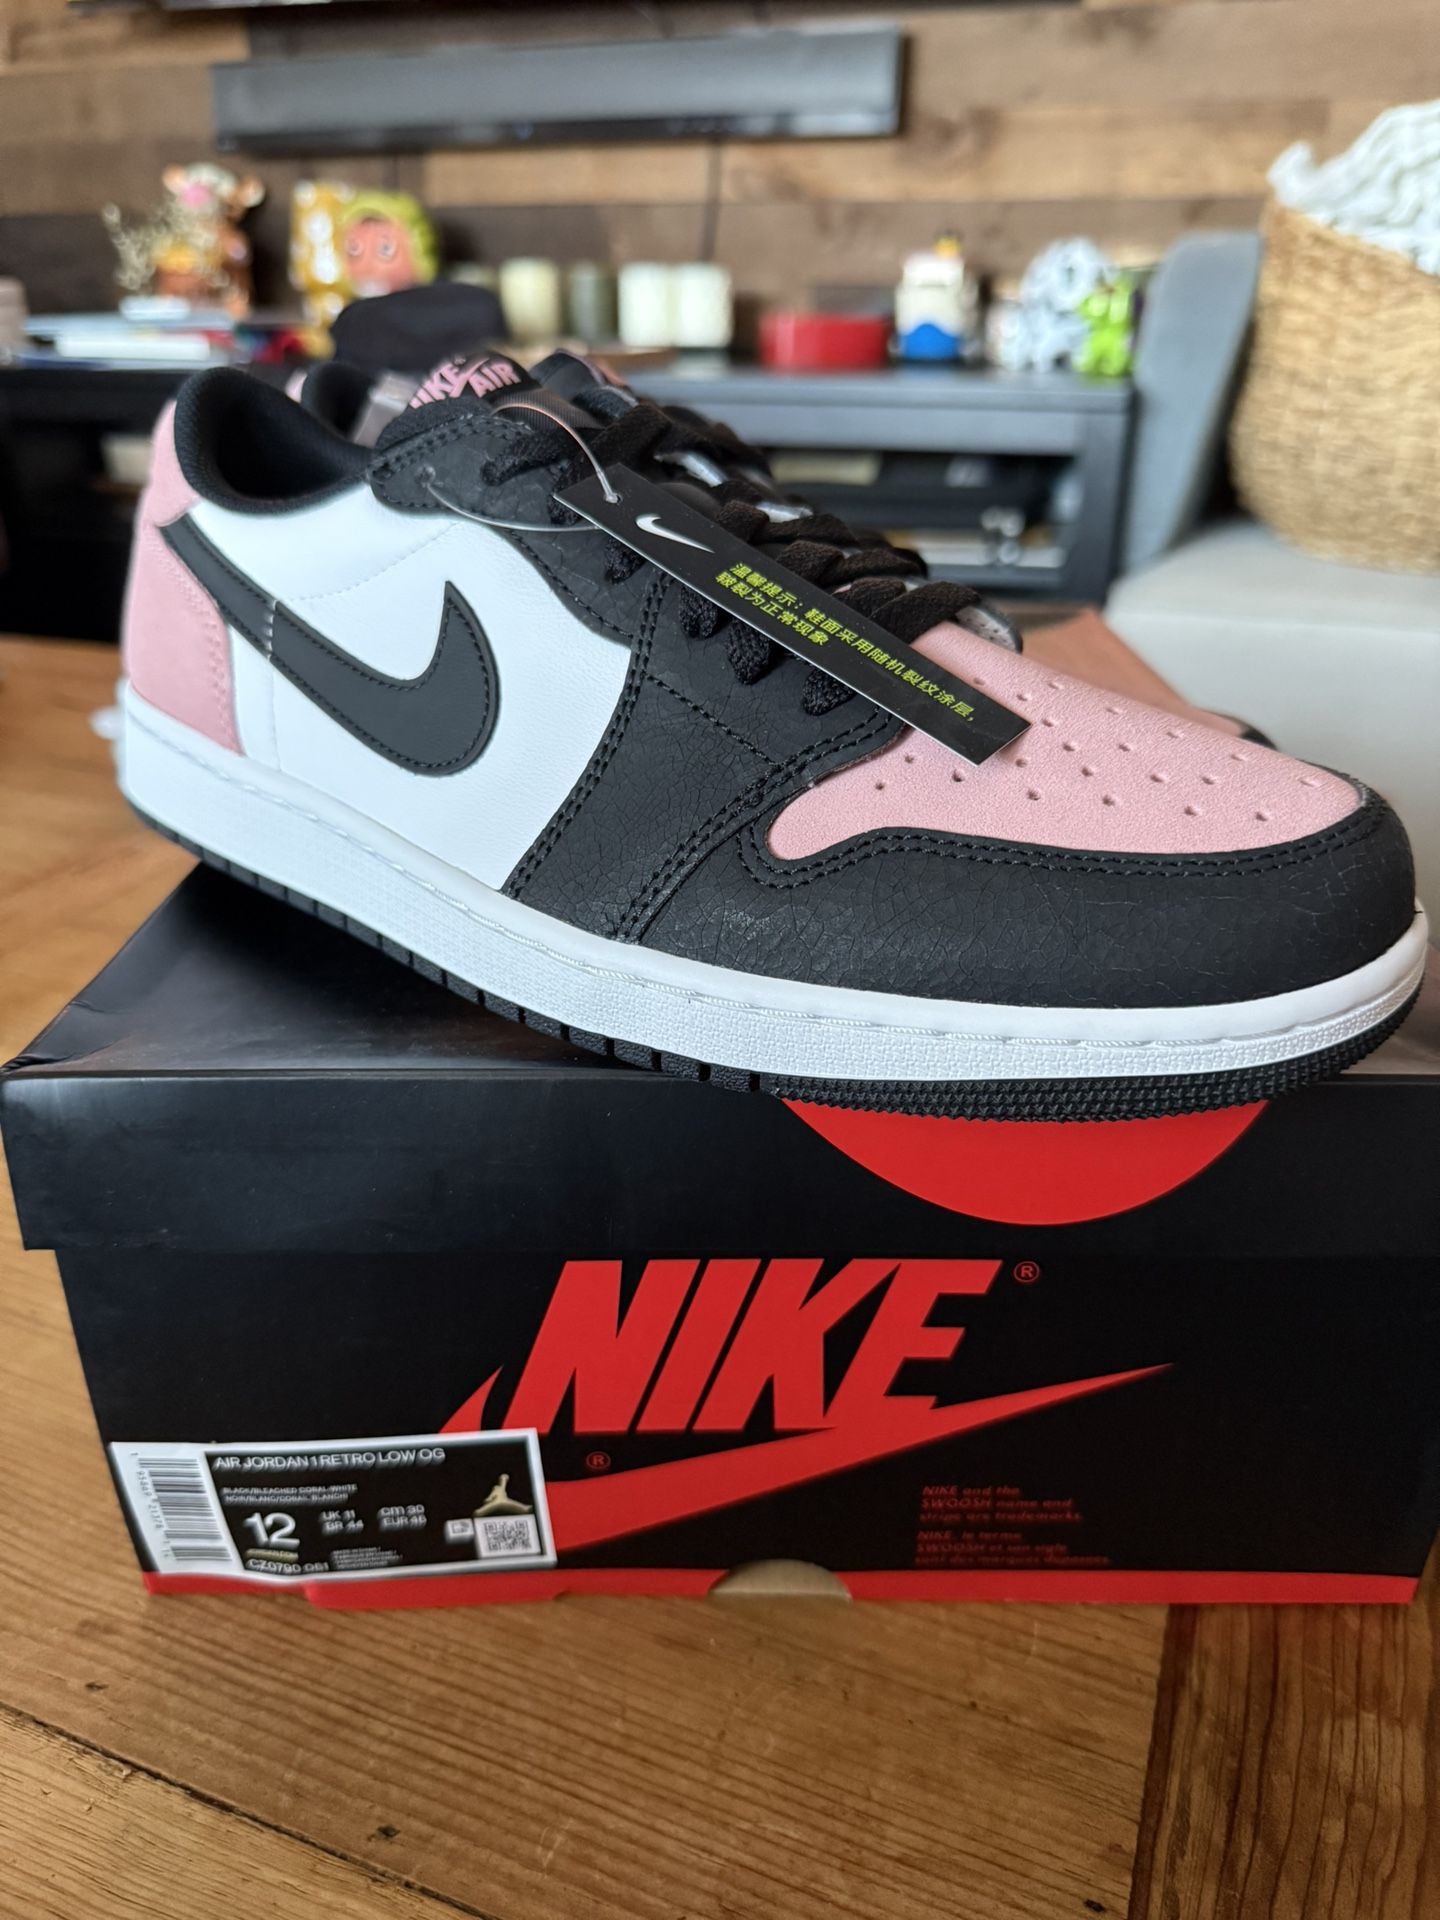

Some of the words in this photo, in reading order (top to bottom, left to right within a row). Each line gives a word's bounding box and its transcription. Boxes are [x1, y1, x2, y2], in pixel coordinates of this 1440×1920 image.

[468, 362, 521, 398] AIR
[502, 1258, 1003, 1433] NIKE
[214, 1456, 241, 1470] AIR
[243, 1455, 309, 1470] JORDAN
[319, 1451, 376, 1468] RETRO
[378, 1449, 416, 1466] LOW
[419, 1447, 446, 1463] OG
[922, 1486, 958, 1496] NIKE
[962, 1487, 992, 1496] and
[996, 1486, 1021, 1496] the
[922, 1498, 992, 1509] SWOOSH
[321, 1510, 341, 1521] UK
[343, 1509, 356, 1520] 11
[995, 1511, 1083, 1521] trademarks
[382, 1516, 408, 1527] EUR
[244, 1512, 300, 1547] 12
